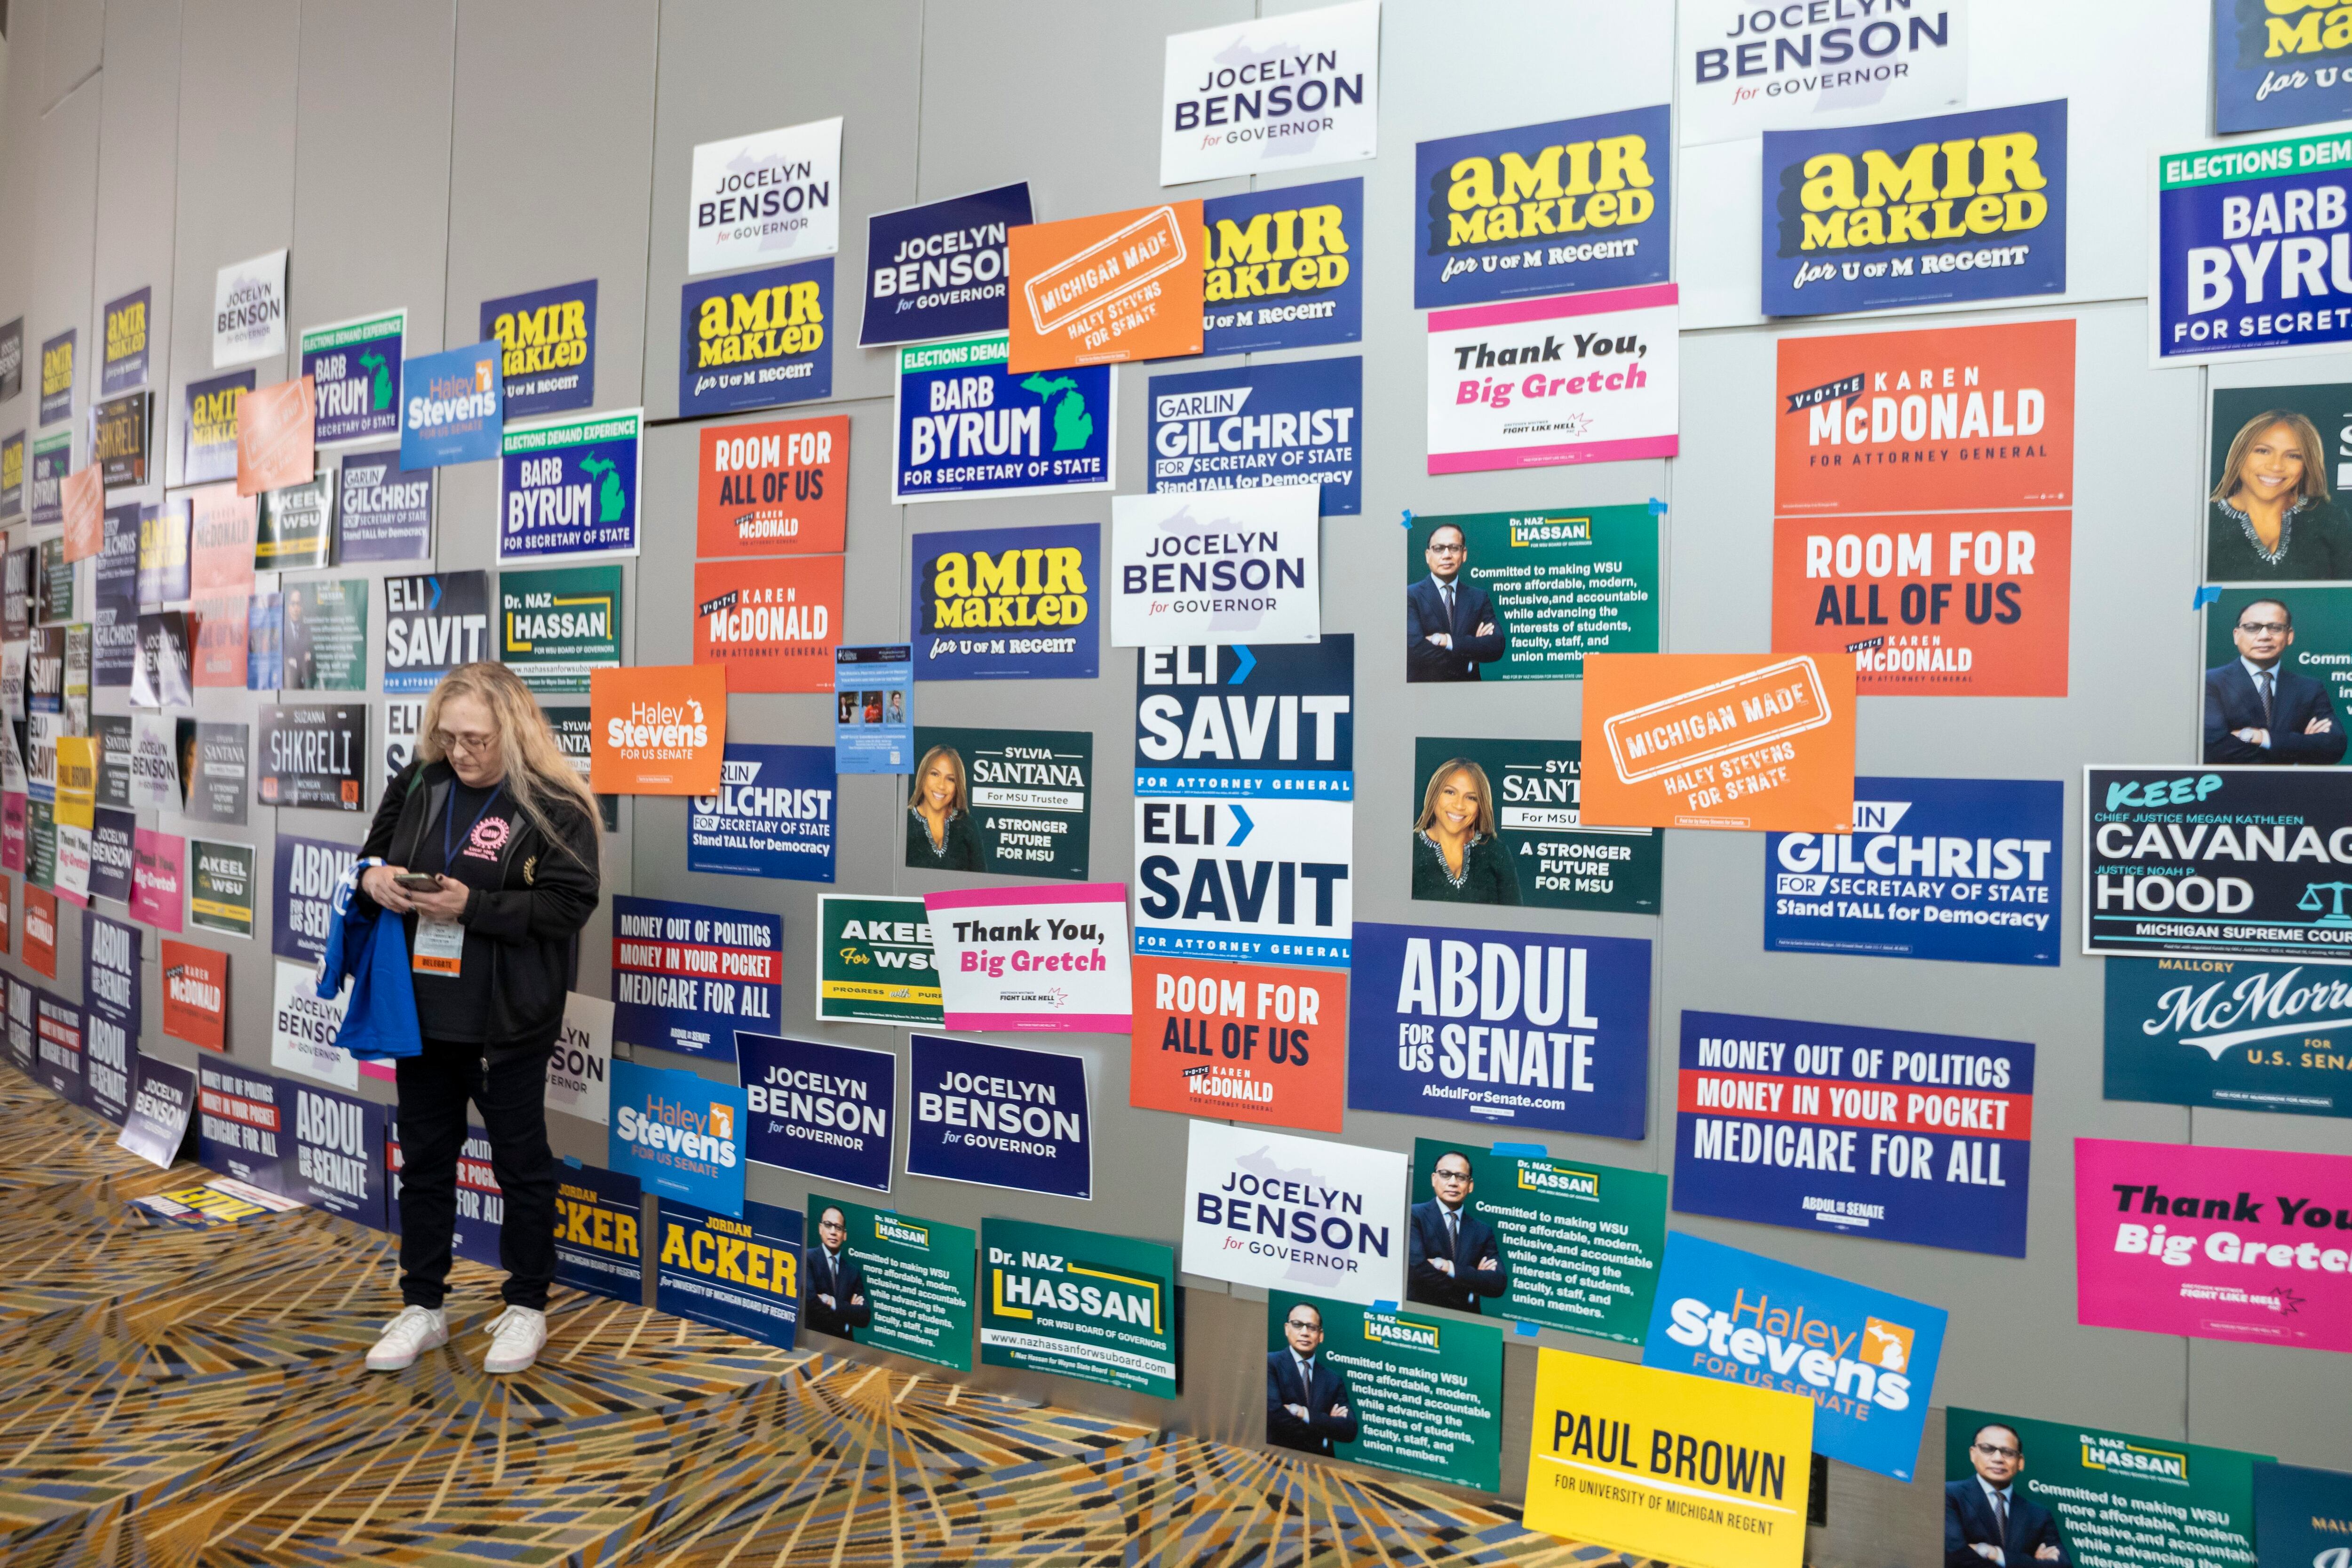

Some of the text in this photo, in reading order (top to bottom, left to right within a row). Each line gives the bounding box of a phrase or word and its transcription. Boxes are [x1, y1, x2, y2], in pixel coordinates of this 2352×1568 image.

[1200, 49, 1336, 92] JOCELYN
[1176, 73, 1364, 132] BENSON
[1201, 118, 1334, 151] for GOVERNOR
[1441, 257, 1478, 282] for
[1482, 255, 1497, 272] U
[1501, 256, 1521, 269] OF
[1523, 252, 1542, 268] M
[227, 282, 271, 308] JOCELYN
[219, 298, 280, 333] BENSON
[304, 319, 400, 350] ELECTIONS DEMAND EXPERIENCE
[316, 354, 347, 383] BARB
[315, 376, 368, 419] YRUM
[318, 413, 395, 437] SECRETARY OF STATE
[346, 470, 379, 486] GARLIN
[343, 482, 429, 514] GILCHRIST
[1524, 517, 1543, 525] NAZ
[1517, 525, 1585, 541] HASSAN
[1470, 562, 1622, 579] Committed to making WSU
[1493, 577, 1637, 591] more affordable, modern,
[505, 593, 551, 609] Dr. NAZ
[1577, 590, 1648, 603] accountable
[1504, 606, 1618, 620] while advancing the
[516, 612, 605, 639] HASSAN
[1510, 620, 1631, 634] interests of students,
[584, 645, 614, 653] GOVERNORS
[1511, 635, 1609, 649] faculty, staff, and
[1512, 652, 1543, 662] union
[294, 710, 326, 724] SUZANNA
[631, 701, 683, 727] Haley
[1625, 683, 1809, 760] MICHIGAN MADE
[608, 717, 707, 748] Stevens
[271, 730, 351, 774] SHKRELI
[620, 749, 692, 760] FOR US SENATE
[1005, 747, 1052, 760] SYLVIA
[973, 759, 1085, 787] SANTANA
[1664, 741, 1796, 796] HALEY STEVENS
[297, 780, 320, 790] MICHIGAN
[1688, 766, 1790, 811] FOR SENATE
[2105, 773, 2223, 812] KEEP
[1007, 793, 1028, 802] MSU
[1032, 795, 1068, 804] Trustee
[986, 818, 1068, 834] A STRONGER
[2095, 812, 2304, 825] CHIEF JUSTICE MEGAN KATHLEEN
[61, 831, 76, 848] Thank
[98, 826, 128, 846] JOCELYN
[1001, 833, 1051, 847] FUTURE
[60, 849, 89, 871] Big Gretch
[92, 840, 132, 869] BENSON
[997, 847, 1054, 862] FOR MSU
[199, 856, 246, 877] AKEEL
[2095, 866, 2144, 876] JUSTICE
[2147, 867, 2182, 876] NOAH
[212, 878, 243, 896] WSU
[2097, 875, 2254, 914] HOOD
[2136, 923, 2219, 938] MICHIGAN
[2223, 926, 2304, 941] SUPREME
[184, 964, 209, 981] KAREN
[2158, 959, 2235, 973] MALLORY
[170, 976, 221, 1012] McDONALD
[1156, 973, 1319, 1025] ROOM FOR
[1161, 1016, 1309, 1066] ALL OF US
[2304, 1039, 2331, 1049] FOR
[2247, 1050, 2291, 1066] U.S.
[1213, 1066, 1250, 1078] KAREN
[1190, 1075, 1273, 1103] McDONALD
[1205, 1098, 1239, 1108] ATTORNEY
[1242, 1104, 1273, 1112] GENERAL
[296, 1089, 368, 1160] ABDUL
[298, 1144, 311, 1160] FOR
[299, 1160, 312, 1178] US
[312, 1147, 368, 1200] SENATE
[706, 1216, 752, 1238] JORDAN
[660, 1223, 797, 1298] ACKER
[660, 1276, 796, 1322] for UNIVERSITY OF MICHIGAN BOARD OF REGENTS
[1553, 1409, 1786, 1501] PAUL BROWN
[1555, 1474, 1773, 1536] FOR UNIVERSITY OF MICHIGAN REGENT
